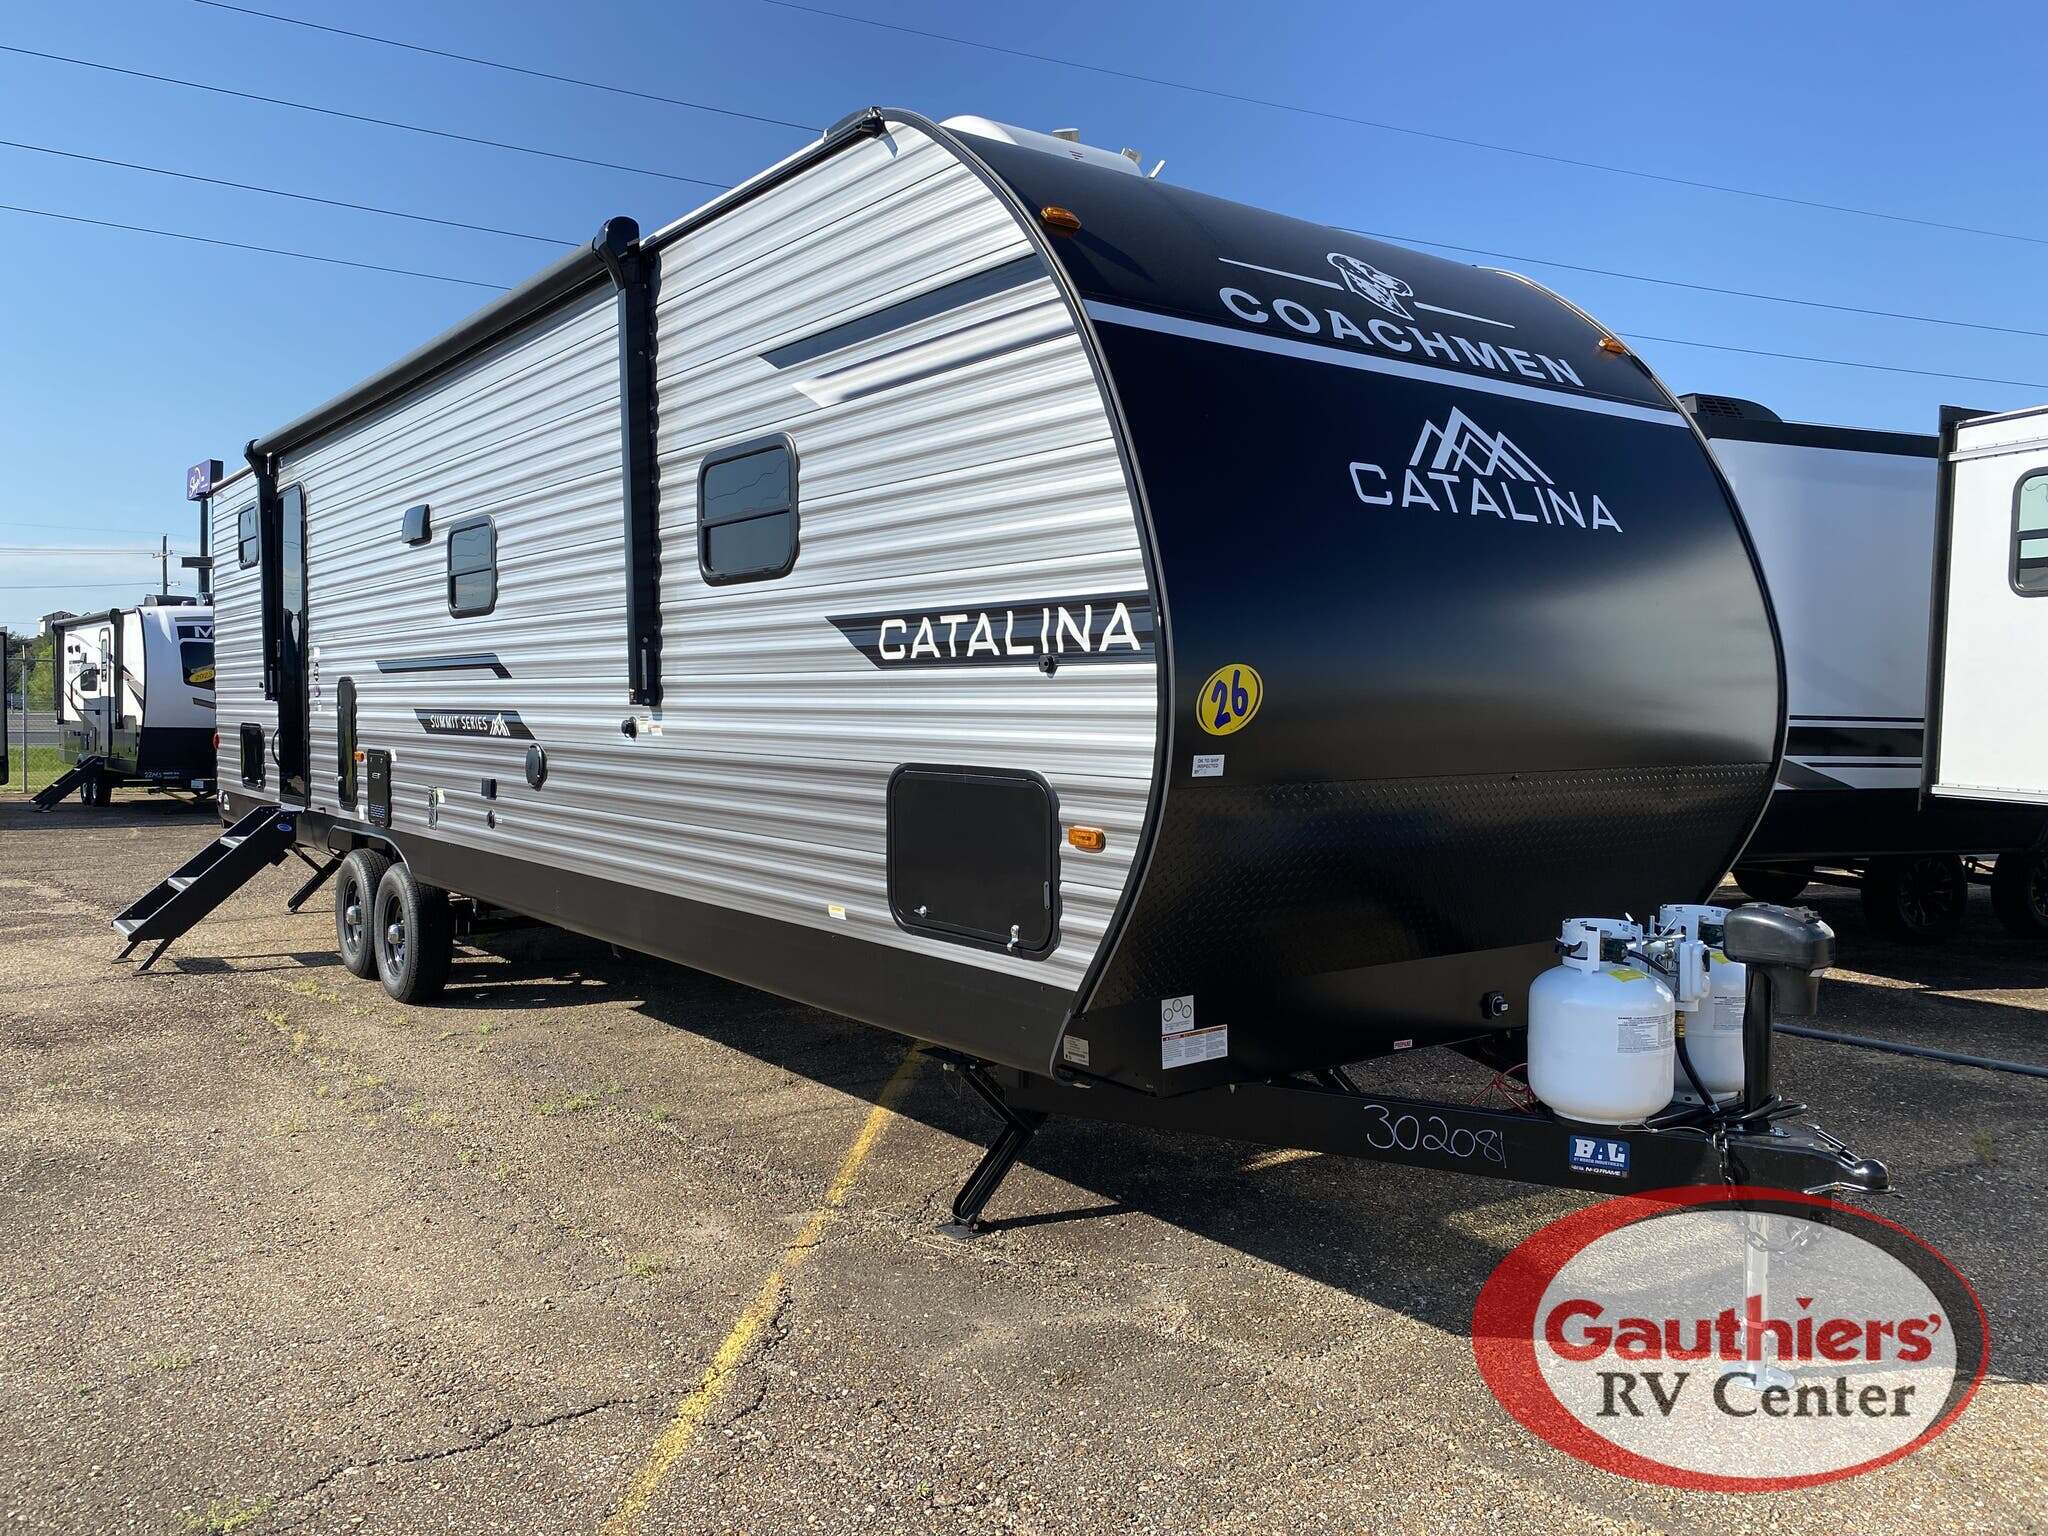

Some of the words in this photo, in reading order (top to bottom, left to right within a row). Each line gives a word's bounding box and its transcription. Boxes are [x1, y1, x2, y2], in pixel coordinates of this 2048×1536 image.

[1219, 287, 1585, 387] COACHMEN
[1348, 461, 1623, 533] CATALINA
[879, 602, 1141, 660] CATALINA
[430, 714, 459, 729] SUMMIT
[461, 715, 488, 731] SERIES
[1211, 669, 1249, 729] 26
[1575, 1138, 1625, 1163] BAL
